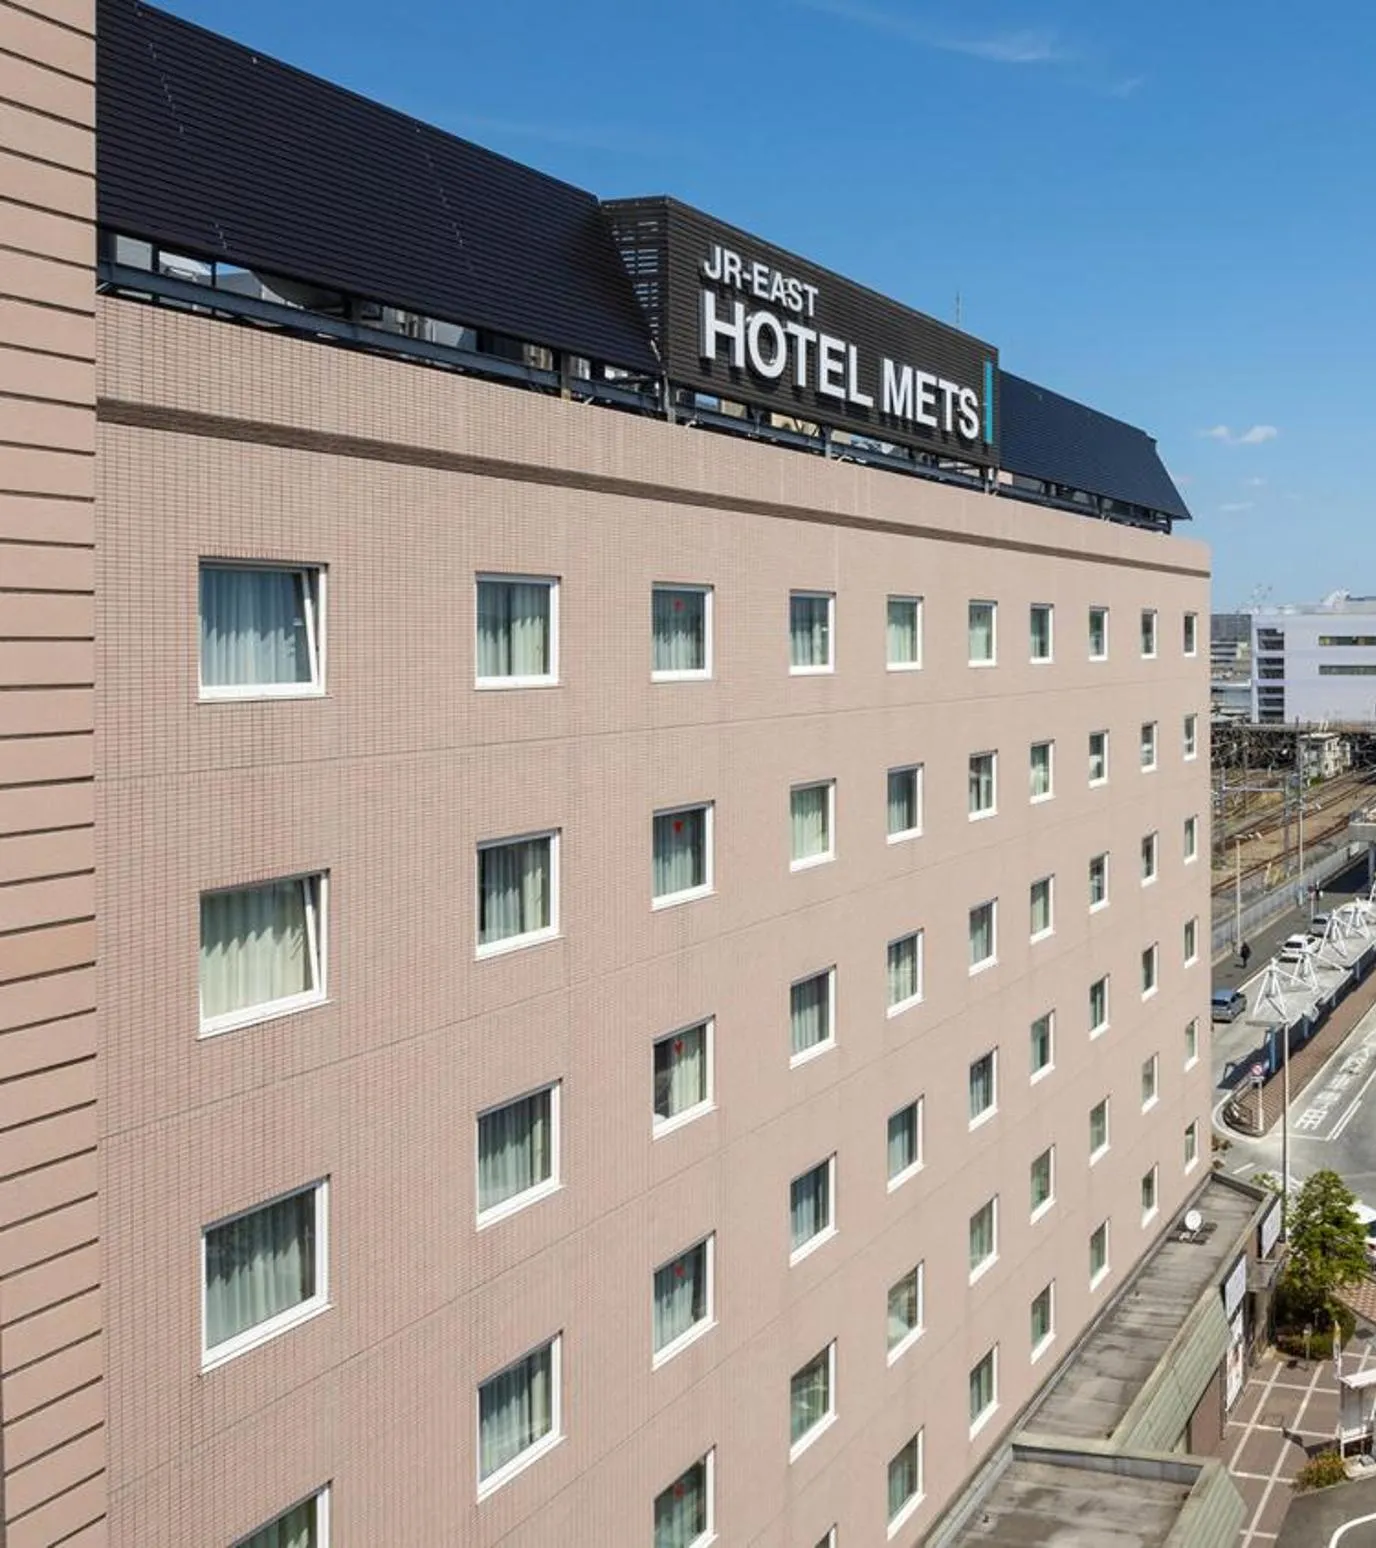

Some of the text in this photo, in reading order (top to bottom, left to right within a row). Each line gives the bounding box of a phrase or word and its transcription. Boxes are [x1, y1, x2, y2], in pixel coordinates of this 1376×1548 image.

[704, 245, 819, 317] JR-EAST
[704, 290, 979, 440] HOTEL METS
